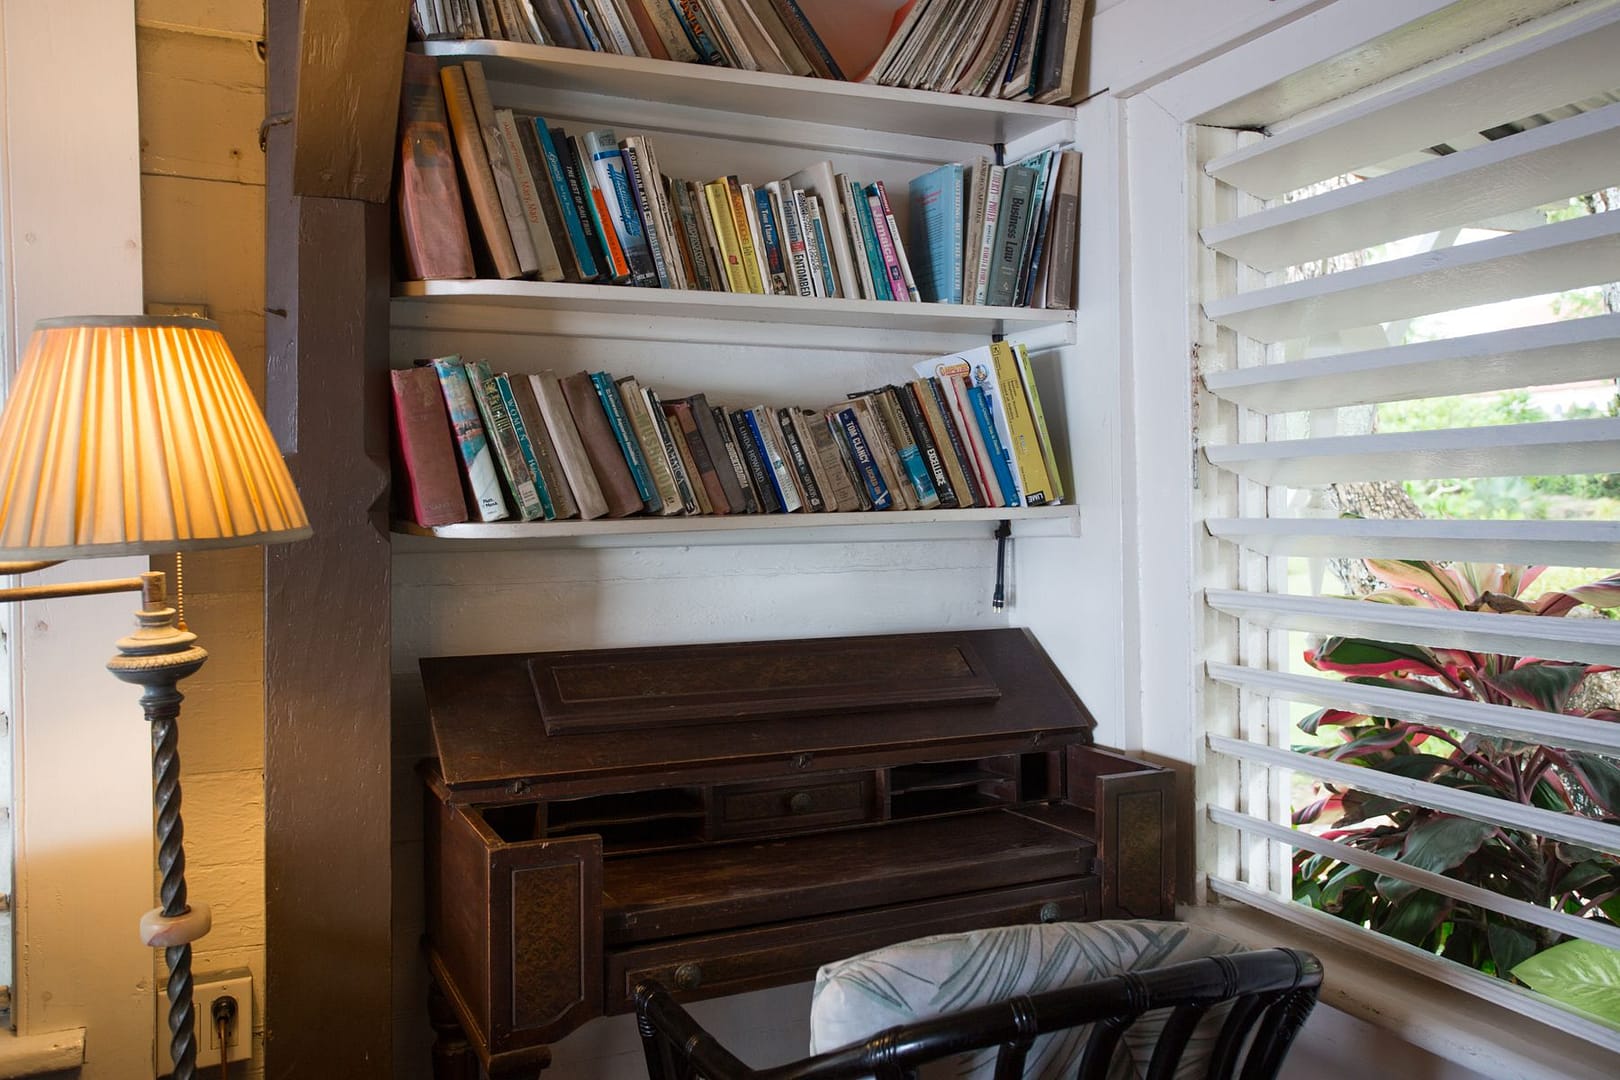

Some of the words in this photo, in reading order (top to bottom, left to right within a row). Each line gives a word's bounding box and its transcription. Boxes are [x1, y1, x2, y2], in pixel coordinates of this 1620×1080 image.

[565, 164, 575, 177] THE
[568, 177, 580, 194] BEST
[628, 150, 644, 189] JONATHAN
[638, 190, 649, 210] AMES
[574, 194, 583, 204] OF
[576, 204, 587, 218] SAIL
[1006, 196, 1024, 239] Business
[781, 198, 801, 242] Fairstein
[792, 253, 813, 298] ENTOMBED
[873, 208, 895, 262] Jamaica
[1002, 240, 1018, 263] Law
[505, 398, 527, 441] WOMEN
[845, 420, 858, 437] TOM
[895, 406, 913, 446] Caribbean
[662, 438, 685, 485] JAMAICA
[738, 424, 752, 449] LINDA
[746, 448, 765, 483] HOWARD
[851, 435, 870, 465] CLANCY
[926, 447, 946, 486] EXCELLENCE
[1025, 491, 1044, 503] LIME
